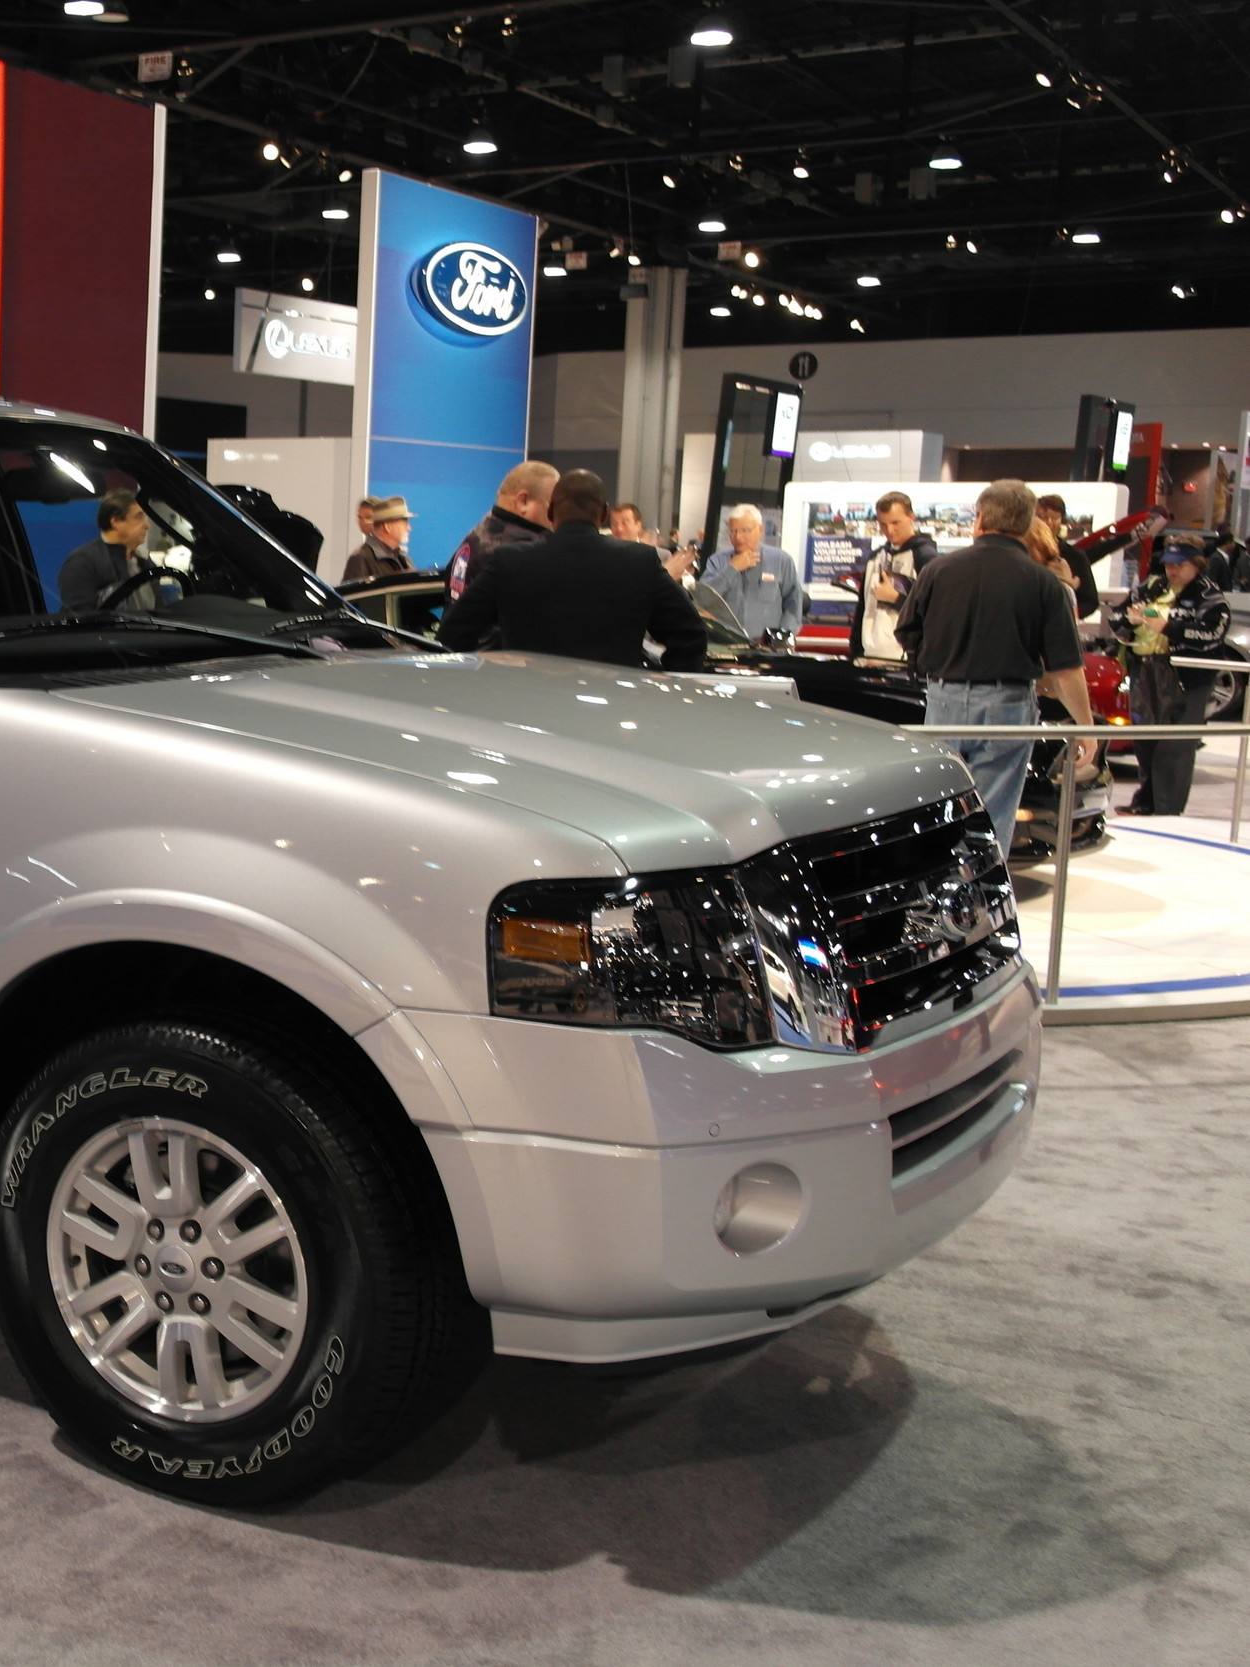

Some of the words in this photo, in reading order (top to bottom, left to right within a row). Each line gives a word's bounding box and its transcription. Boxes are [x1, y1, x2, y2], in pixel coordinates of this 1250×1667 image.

[144, 56, 167, 66] FIRE
[451, 251, 516, 321] Ford
[289, 330, 351, 360] LEXUS
[813, 540, 853, 549] UNLEASH
[813, 548, 837, 557] YOUR
[837, 548, 863, 557] INNER
[1, 1067, 208, 1209] WRANGLER
[110, 1335, 345, 1479] GOODYEAR
